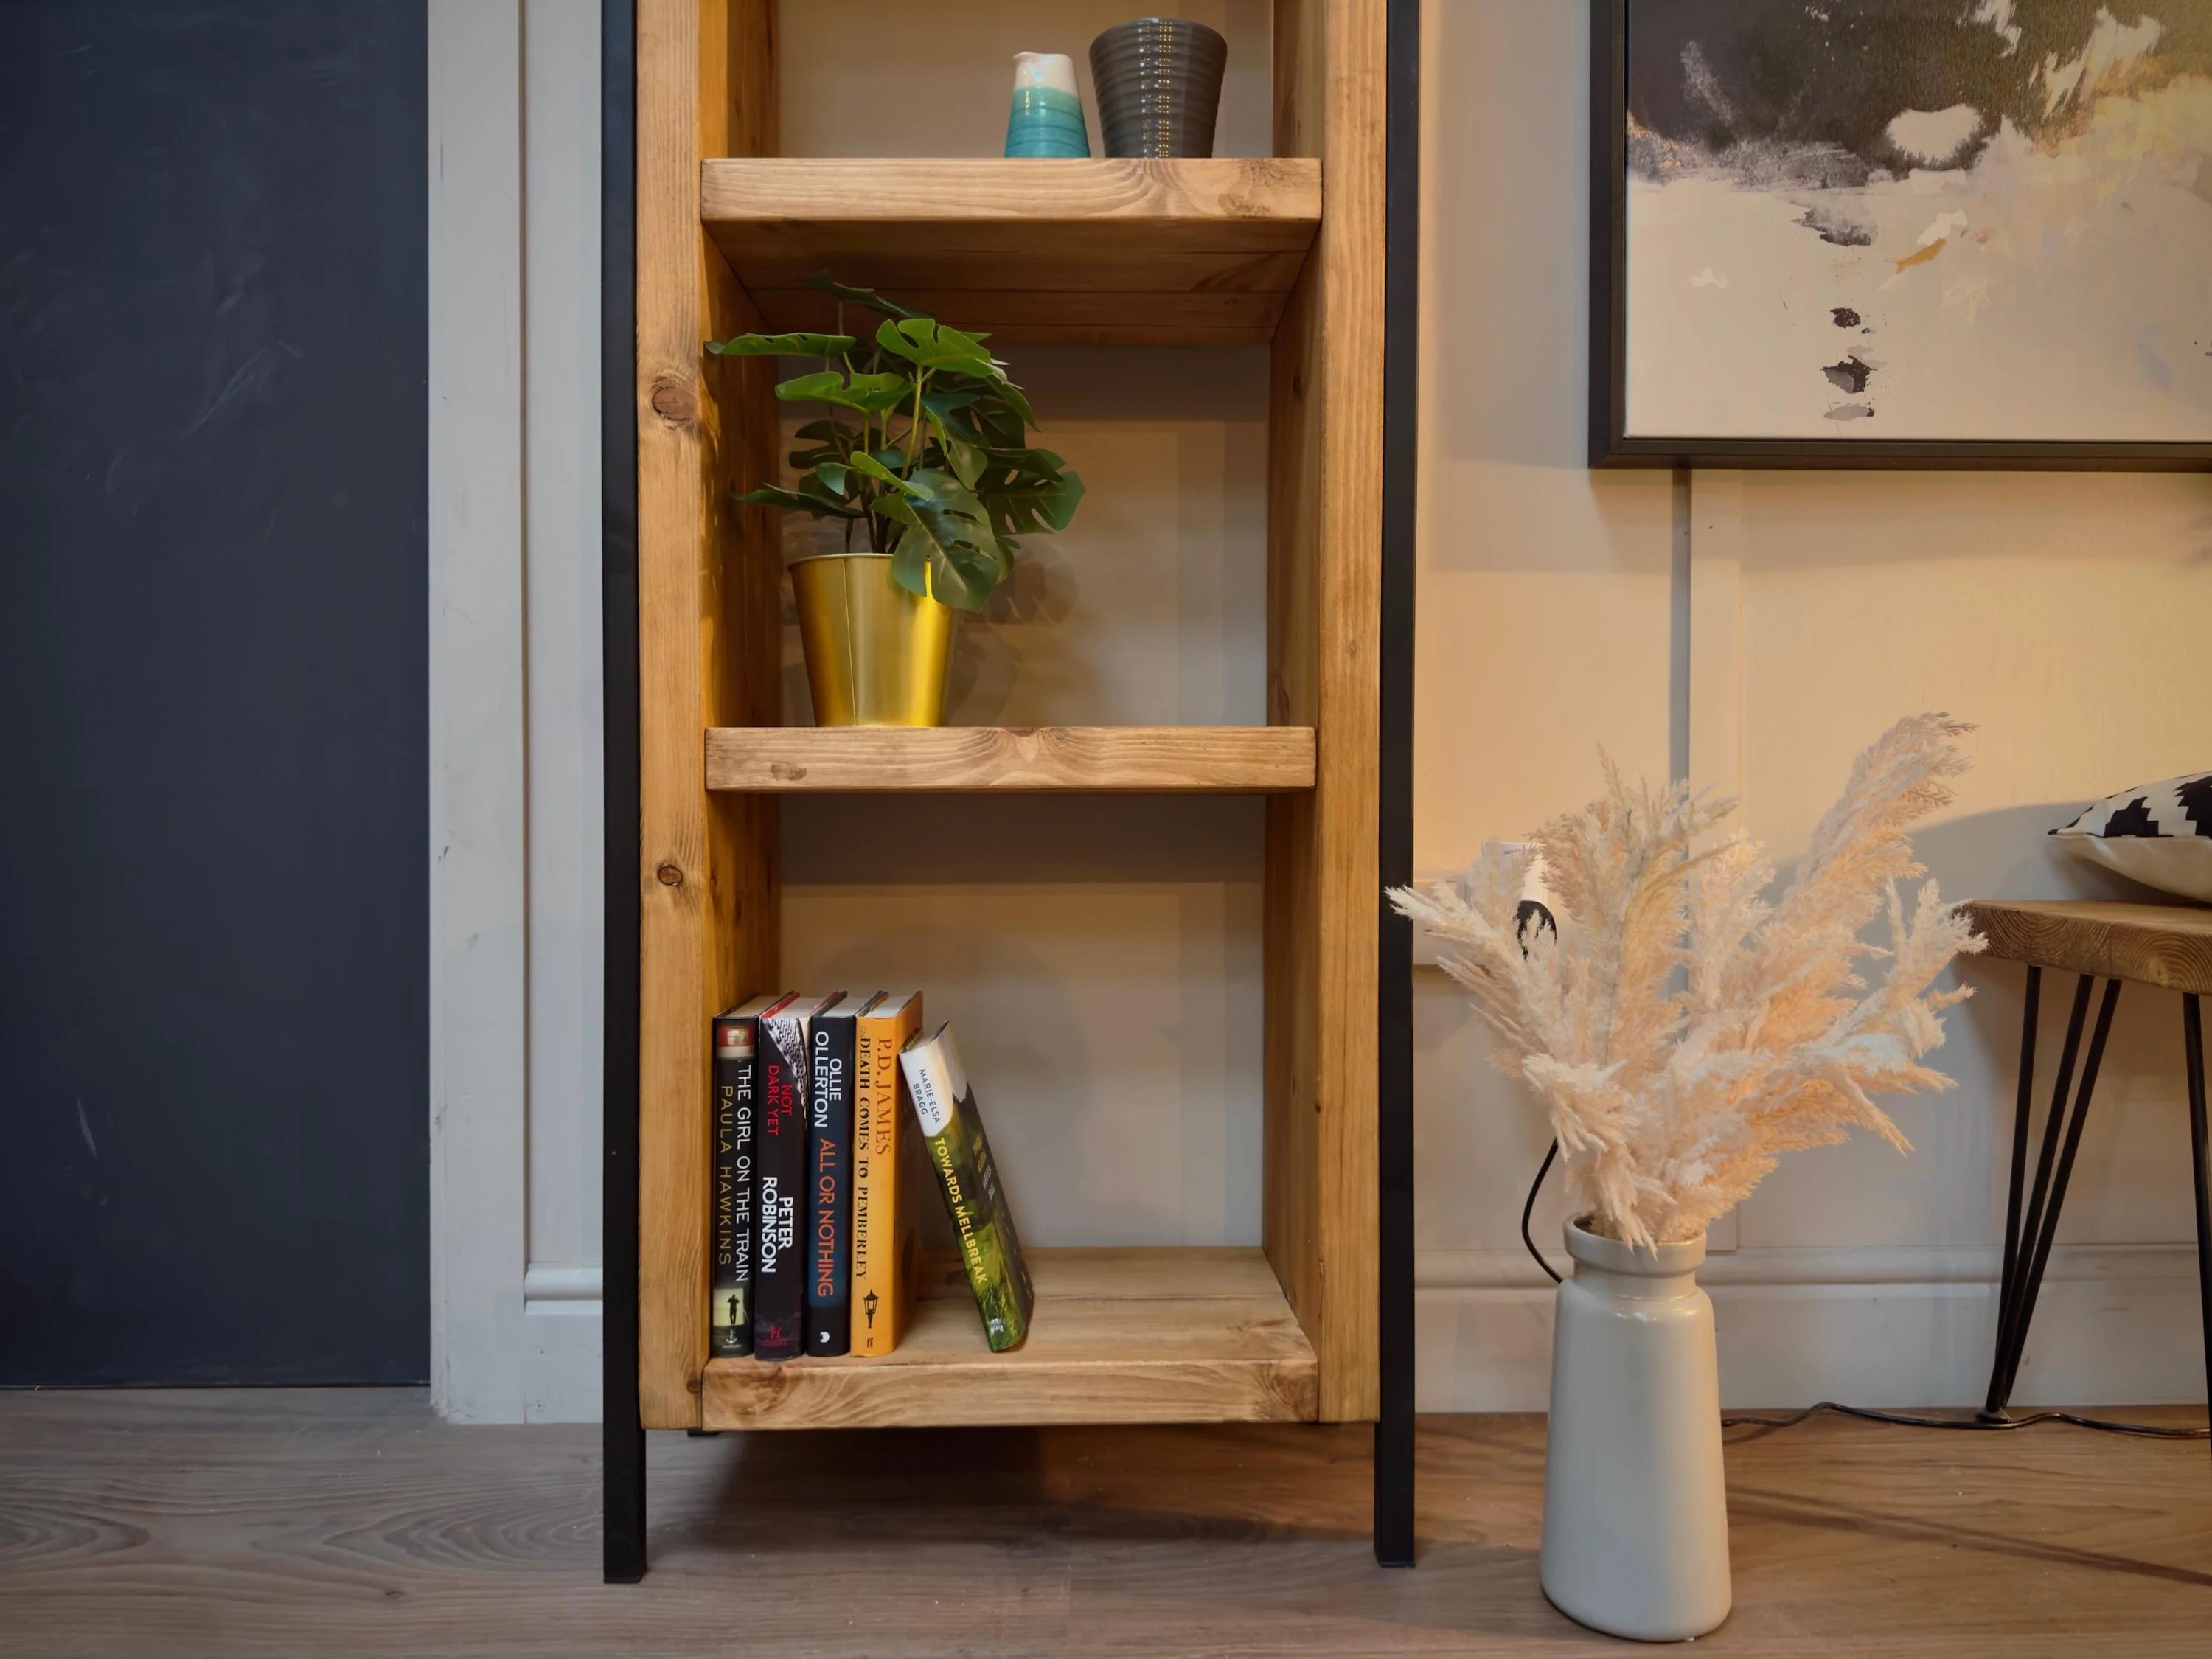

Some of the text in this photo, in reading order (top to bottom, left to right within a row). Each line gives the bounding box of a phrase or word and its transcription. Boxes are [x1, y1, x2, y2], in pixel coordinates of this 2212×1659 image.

[767, 1065, 779, 1136] DARK YET
[781, 1085, 793, 1116] NOT
[814, 1031, 830, 1127] OLLERTON
[829, 1058, 842, 1101] OLLIE
[874, 1038, 892, 1155] P.D. JAMES
[913, 1083, 928, 1115] BRAGG
[919, 1069, 942, 1124] MARIE-ELSA
[719, 1085, 734, 1265] PAULA HAWKINS
[736, 1065, 751, 1281] THE GIRL ON THE TRAIN
[856, 1038, 871, 1280] DEATH COMES TO PEMBERLEY
[761, 1177, 778, 1273] ROBINSON
[778, 1197, 793, 1251] PETER
[817, 1138, 836, 1298] ALL OR NOTHING
[935, 1138, 963, 1203] TOWARDS
[955, 1206, 988, 1284] MELLBREAK
